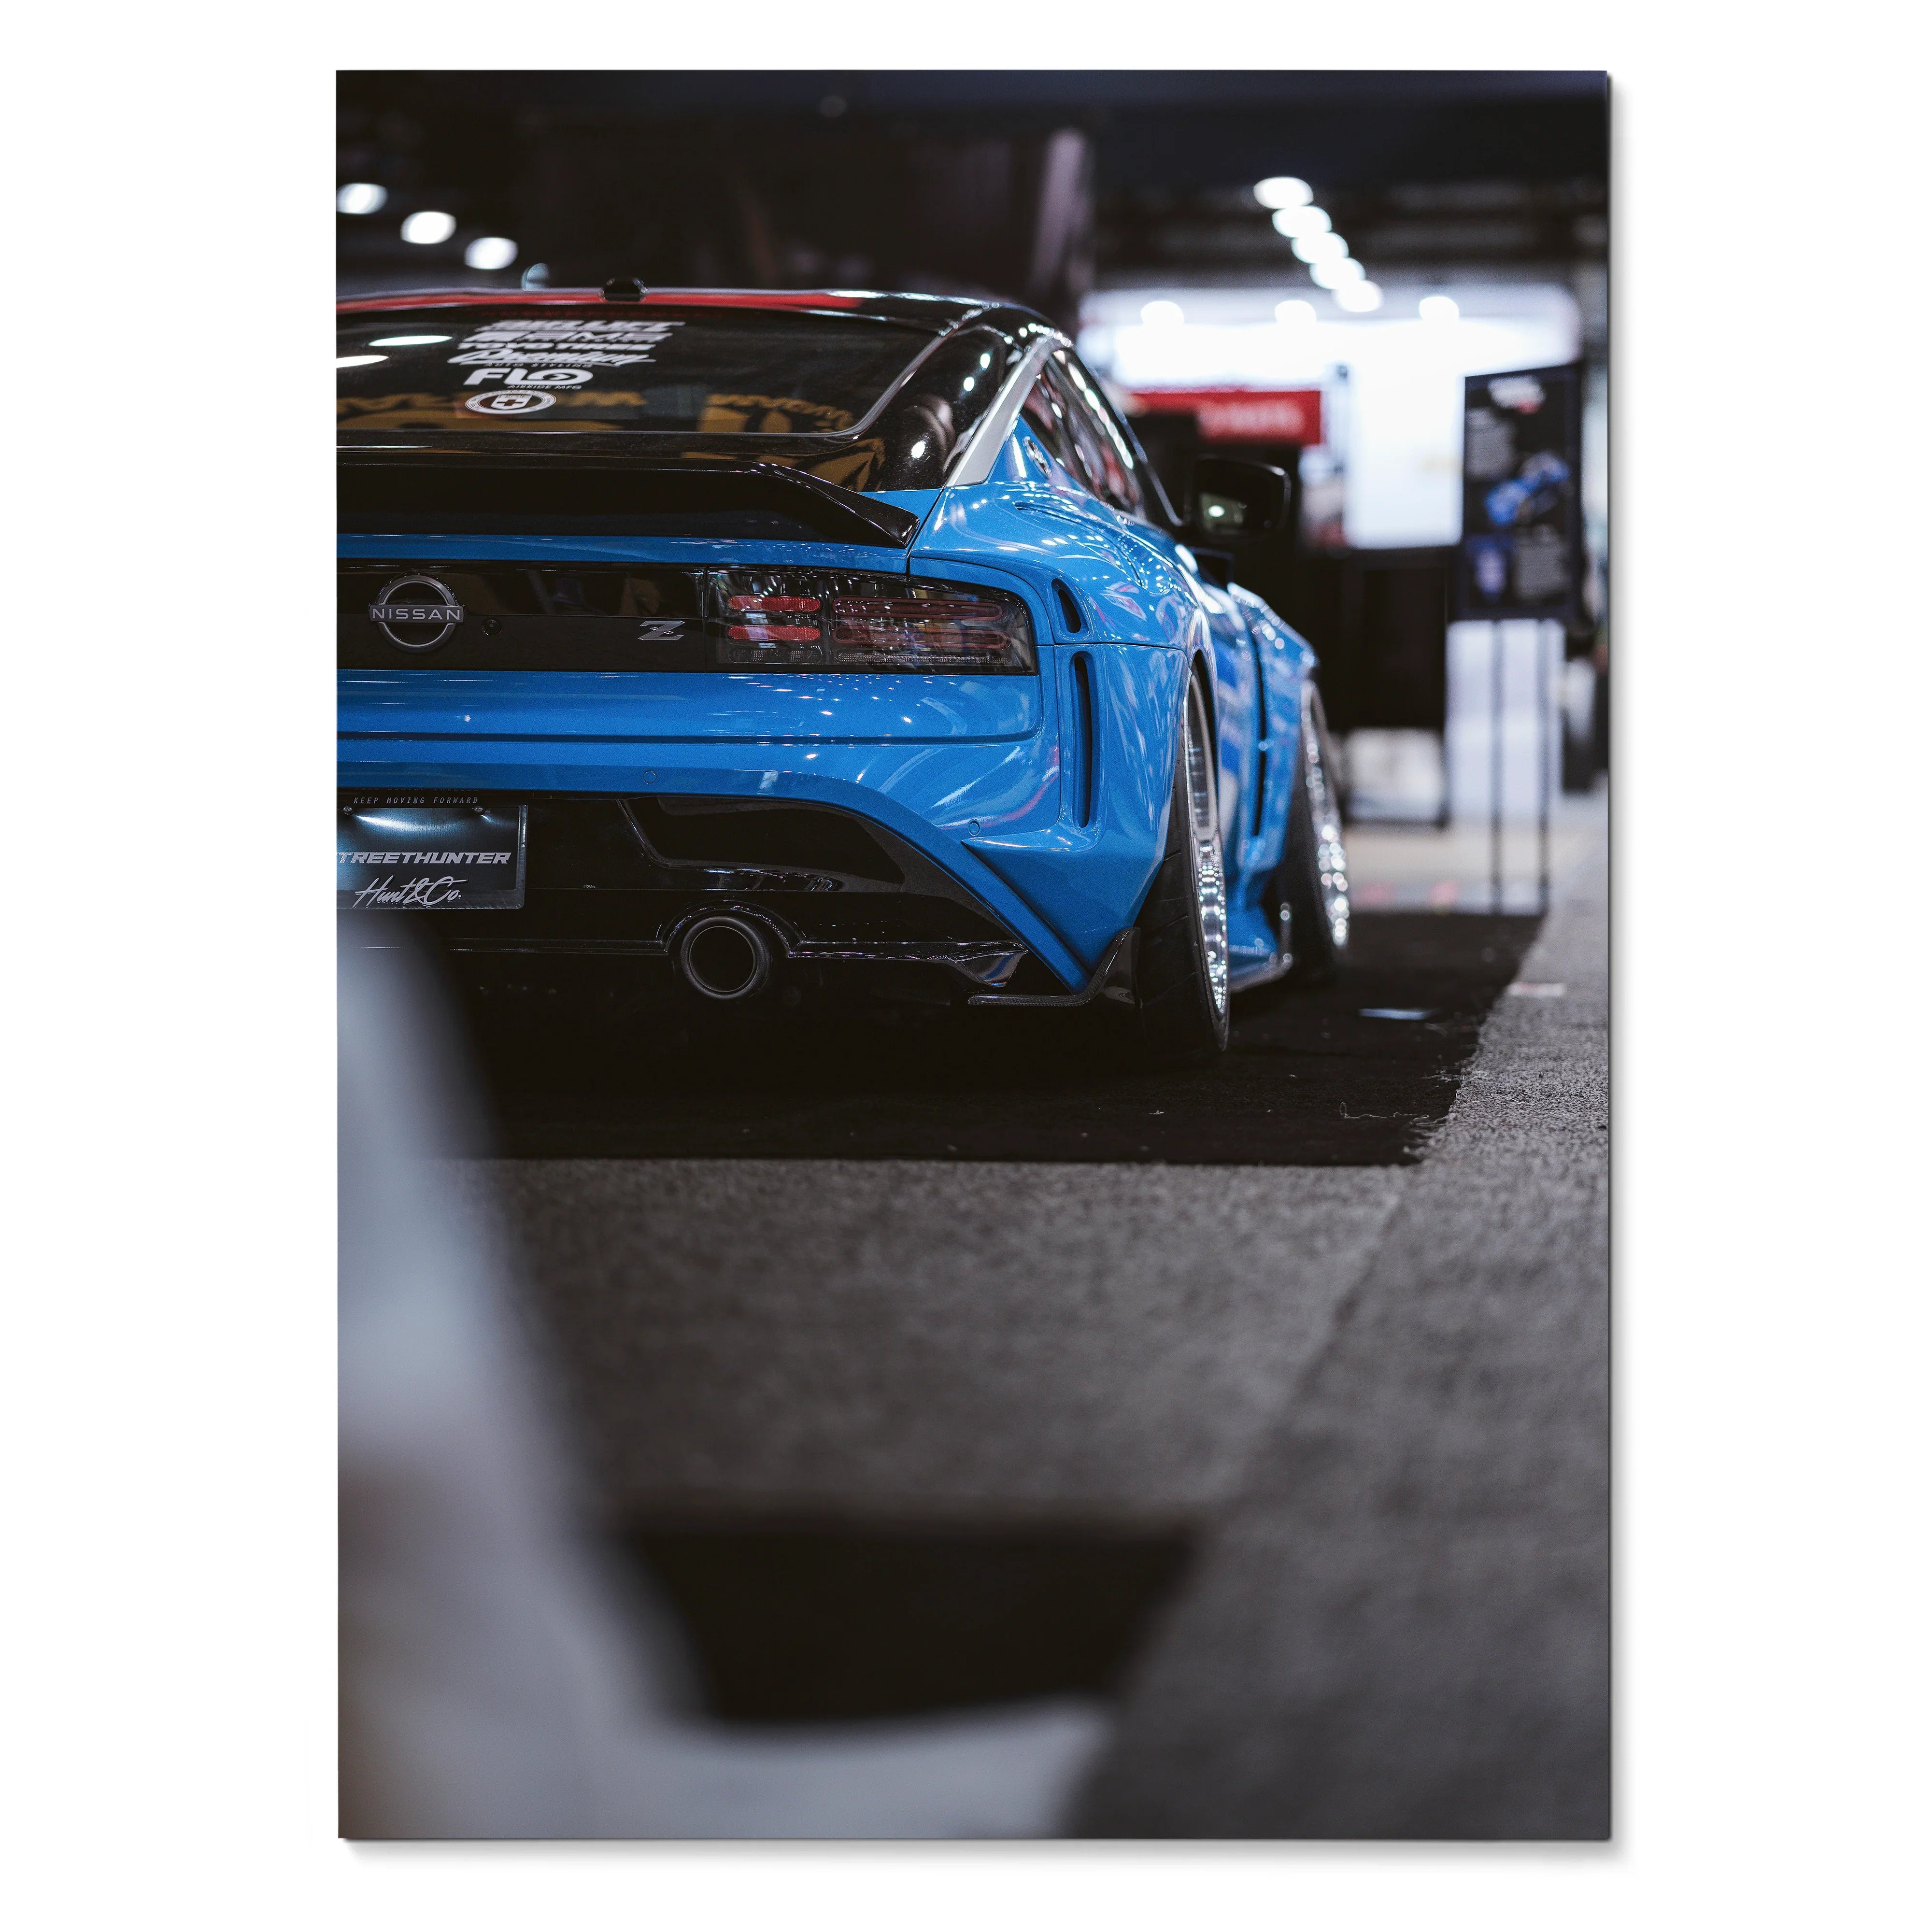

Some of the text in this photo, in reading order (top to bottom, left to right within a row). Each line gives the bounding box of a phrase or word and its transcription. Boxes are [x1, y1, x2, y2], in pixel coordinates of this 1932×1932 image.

[555, 342, 656, 351] TIRES
[463, 368, 594, 385] FLO
[373, 608, 460, 621] NISSAN
[638, 620, 685, 641] Z
[337, 852, 511, 864] TREETHUNTER
